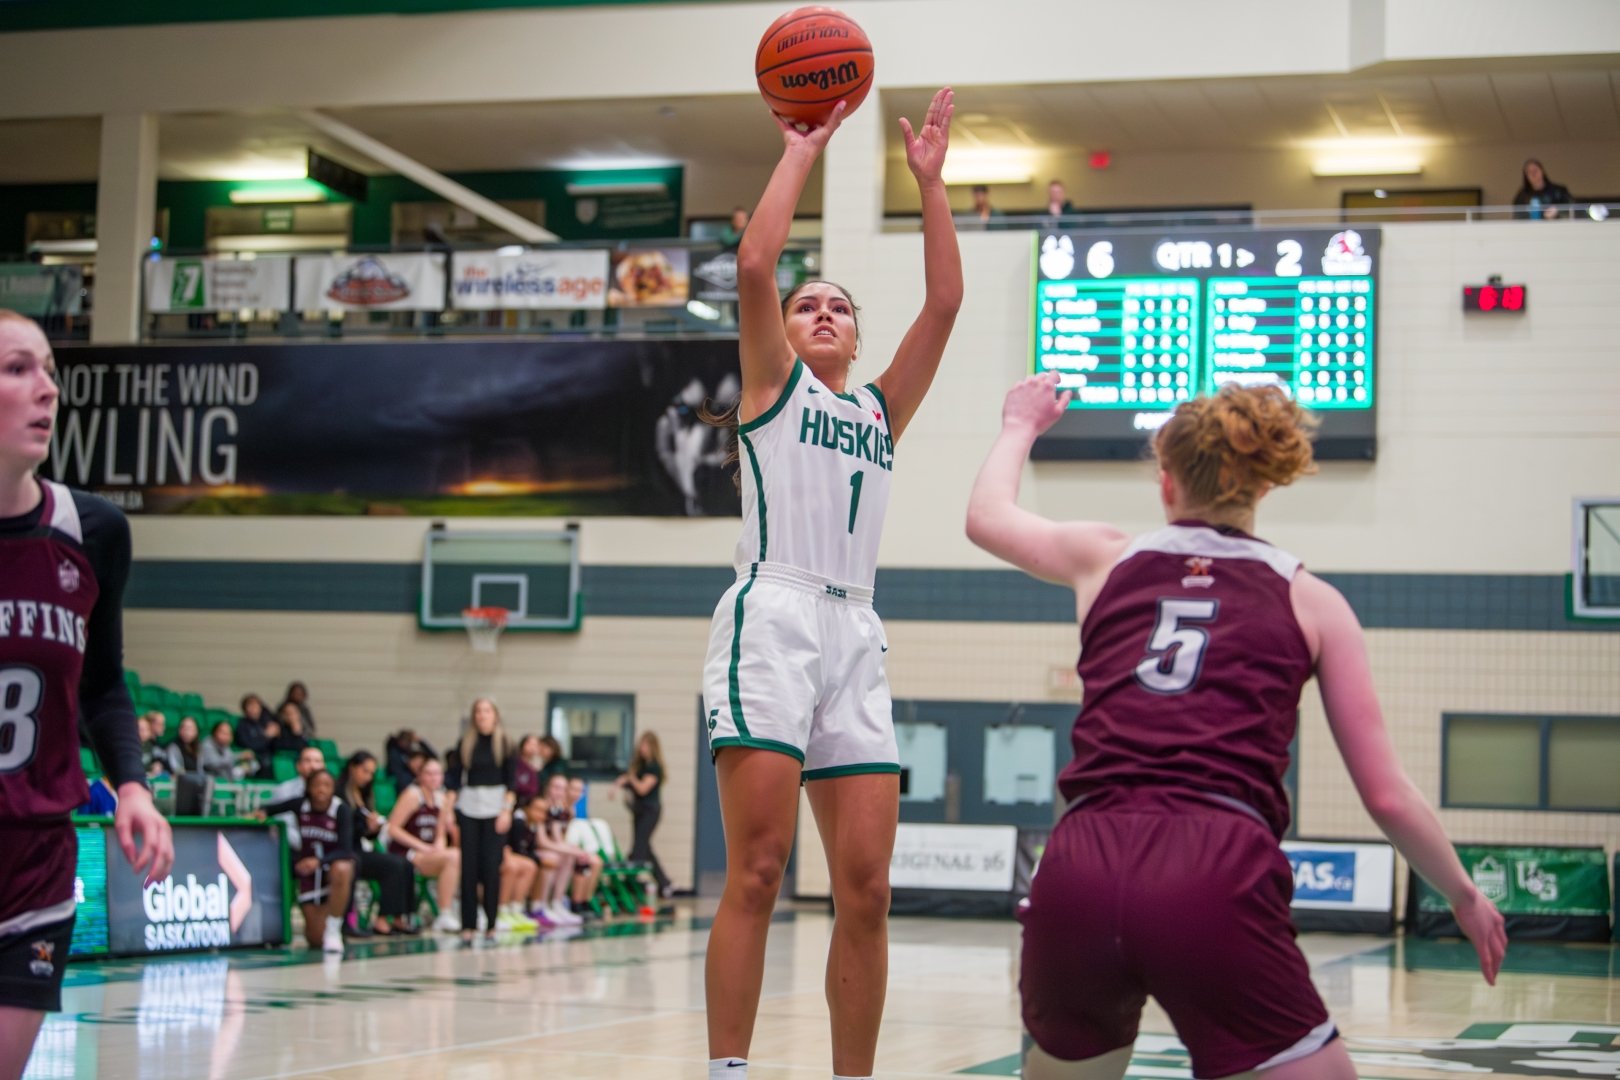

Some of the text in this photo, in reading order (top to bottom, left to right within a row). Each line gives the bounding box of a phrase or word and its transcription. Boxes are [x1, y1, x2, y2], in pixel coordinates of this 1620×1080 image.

[781, 60, 859, 90] Wilson
[1086, 241, 1114, 278] 6
[1156, 241, 1212, 271] QTR
[1275, 239, 1302, 276] 2
[455, 273, 603, 300] wireless age
[55, 363, 259, 407] NOT THE WIND
[848, 470, 864, 535] 1
[1134, 599, 1217, 692] 5
[143, 873, 230, 923] Global
[144, 920, 231, 950] SASKATOON
